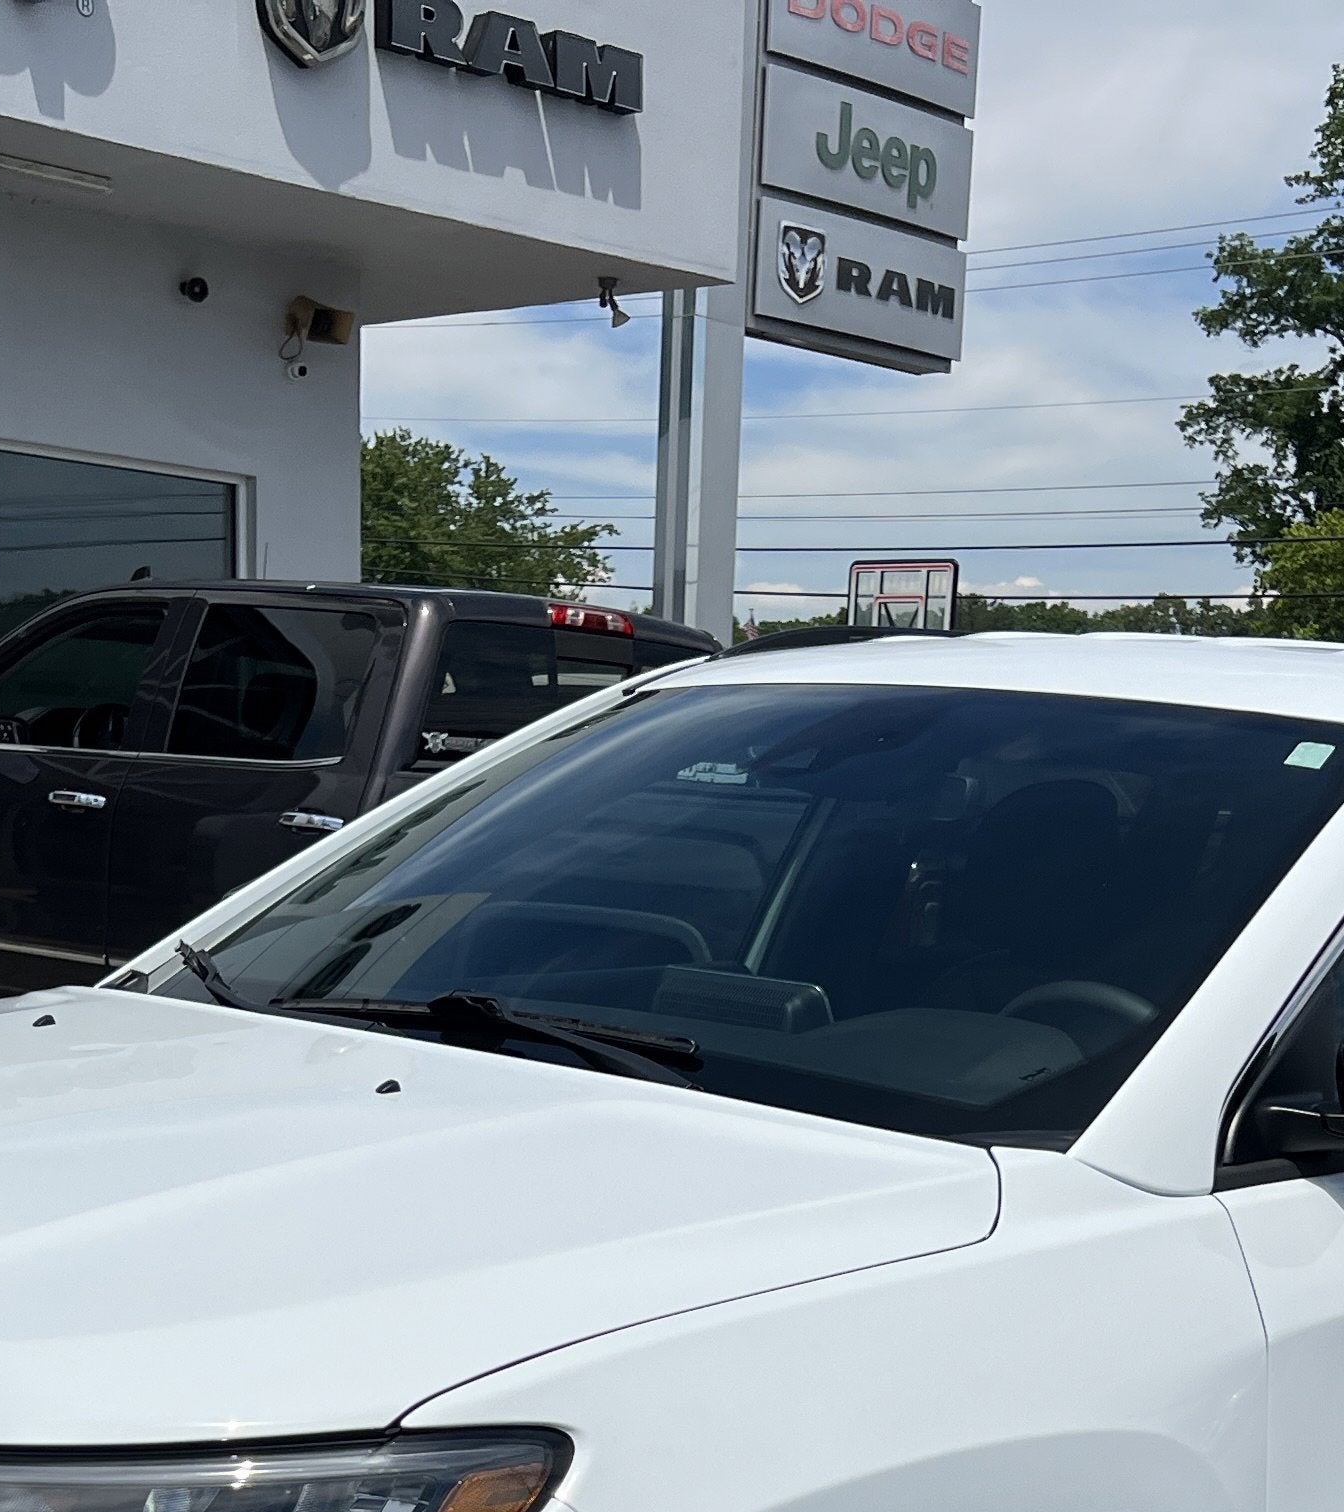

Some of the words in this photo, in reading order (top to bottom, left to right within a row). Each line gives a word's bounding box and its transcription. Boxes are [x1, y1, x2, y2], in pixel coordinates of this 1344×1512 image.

[374, 0, 644, 115] RAM
[816, 101, 937, 209] Jeep
[836, 256, 955, 320] RAM
